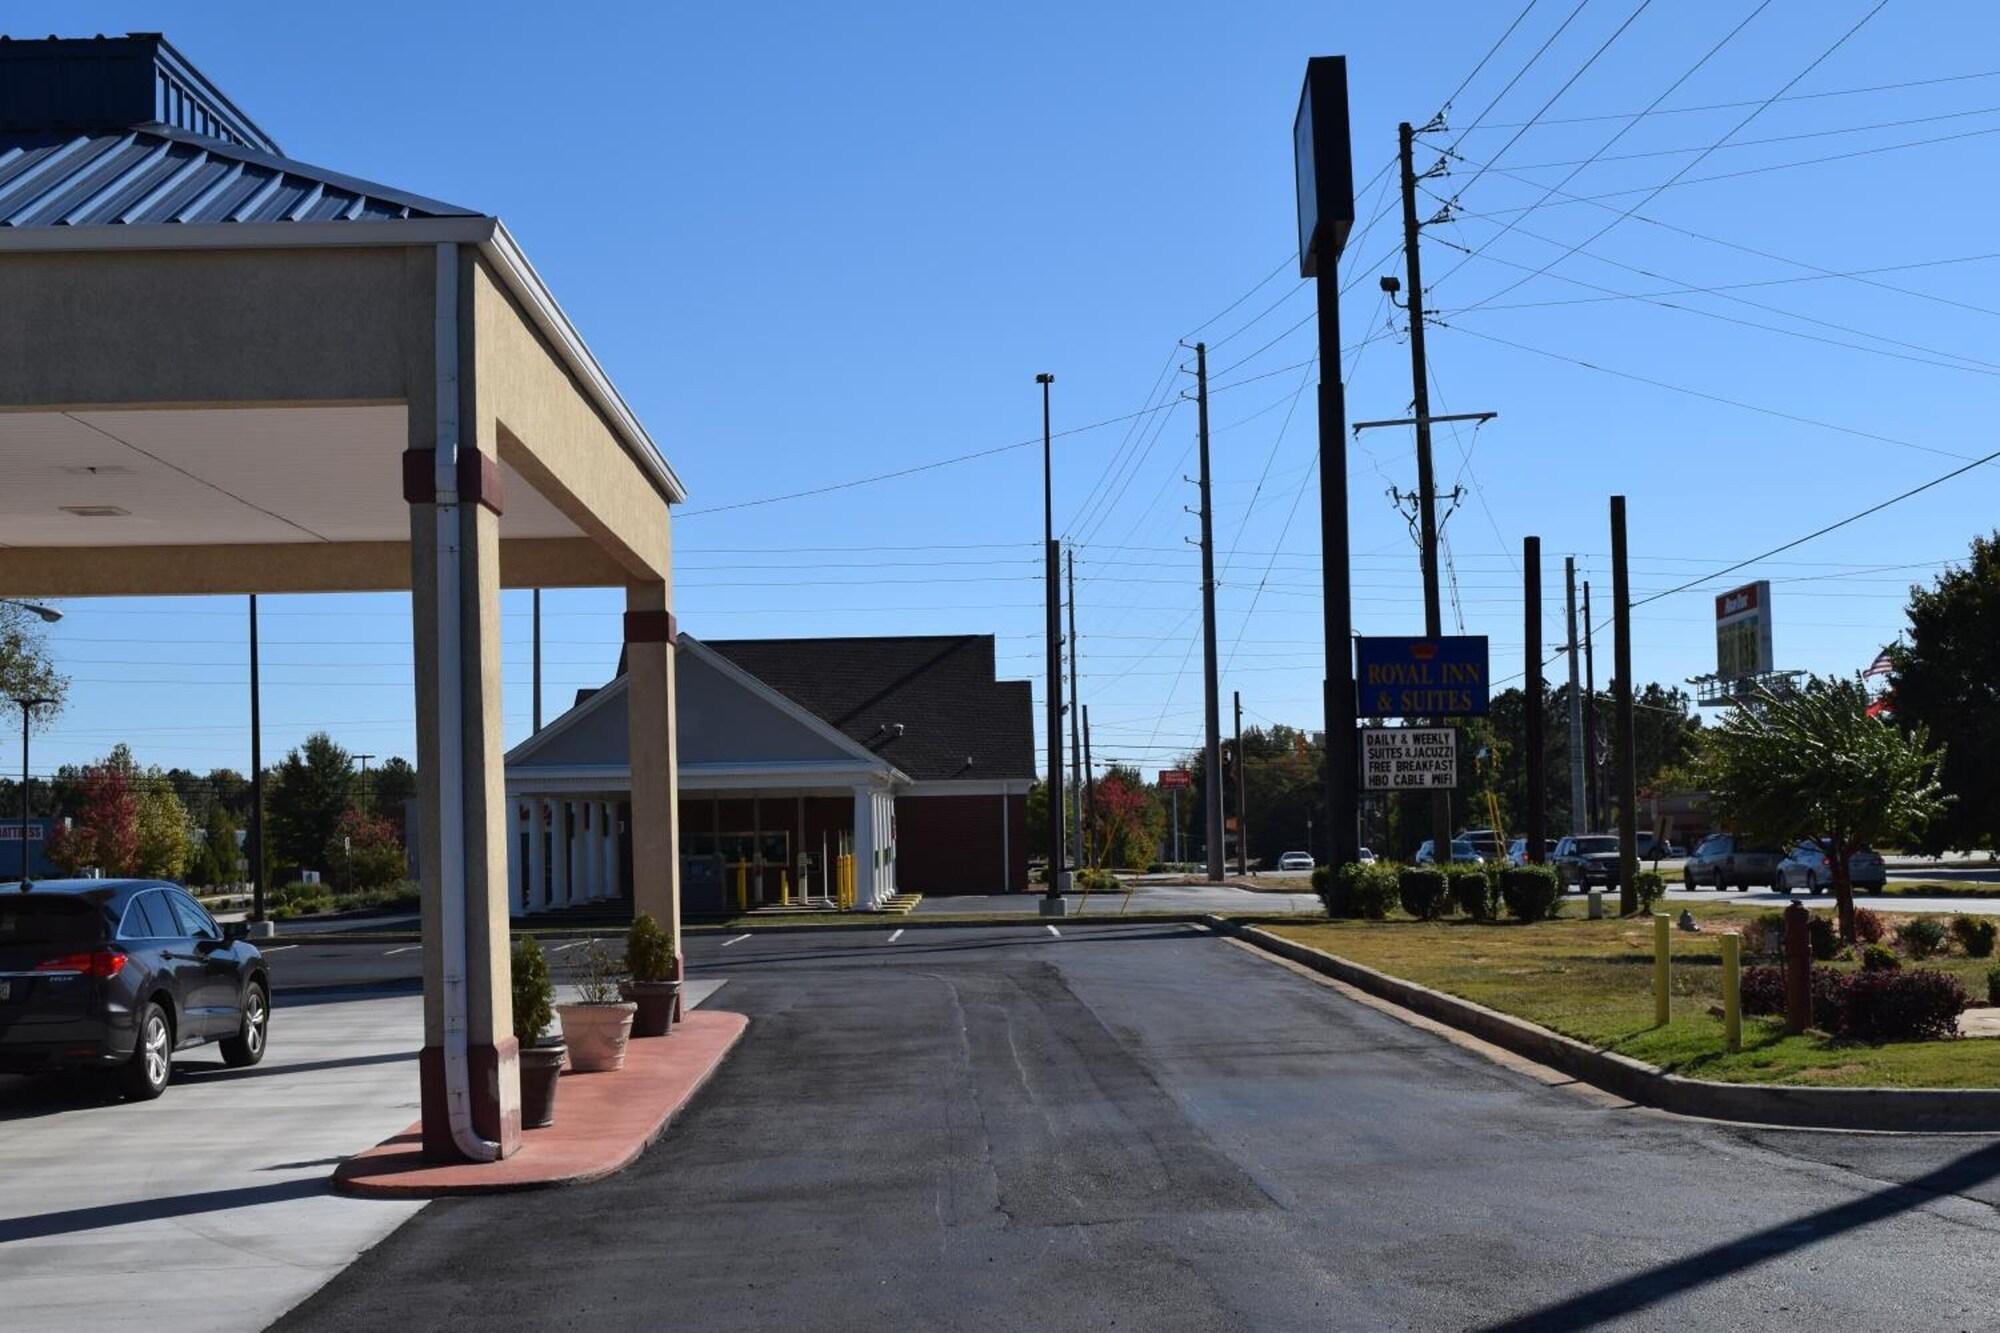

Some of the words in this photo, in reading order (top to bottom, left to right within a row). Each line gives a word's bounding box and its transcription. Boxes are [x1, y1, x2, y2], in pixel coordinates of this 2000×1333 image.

[1368, 663, 1433, 685] ROYAL
[1440, 663, 1481, 685] INN
[1377, 690, 1392, 712] &
[1401, 690, 1472, 712] SUITES
[1367, 734, 1396, 746] DAILY
[1401, 734, 1408, 745] &
[1412, 733, 1449, 745] WEEKLY
[1368, 747, 1403, 759] SUITES
[1369, 761, 1392, 773] FREE
[1396, 760, 1453, 772] BREAKFAST
[1369, 774, 1389, 786] HBO
[1394, 774, 1424, 785] CABLE
[1431, 773, 1453, 785] WIFI
